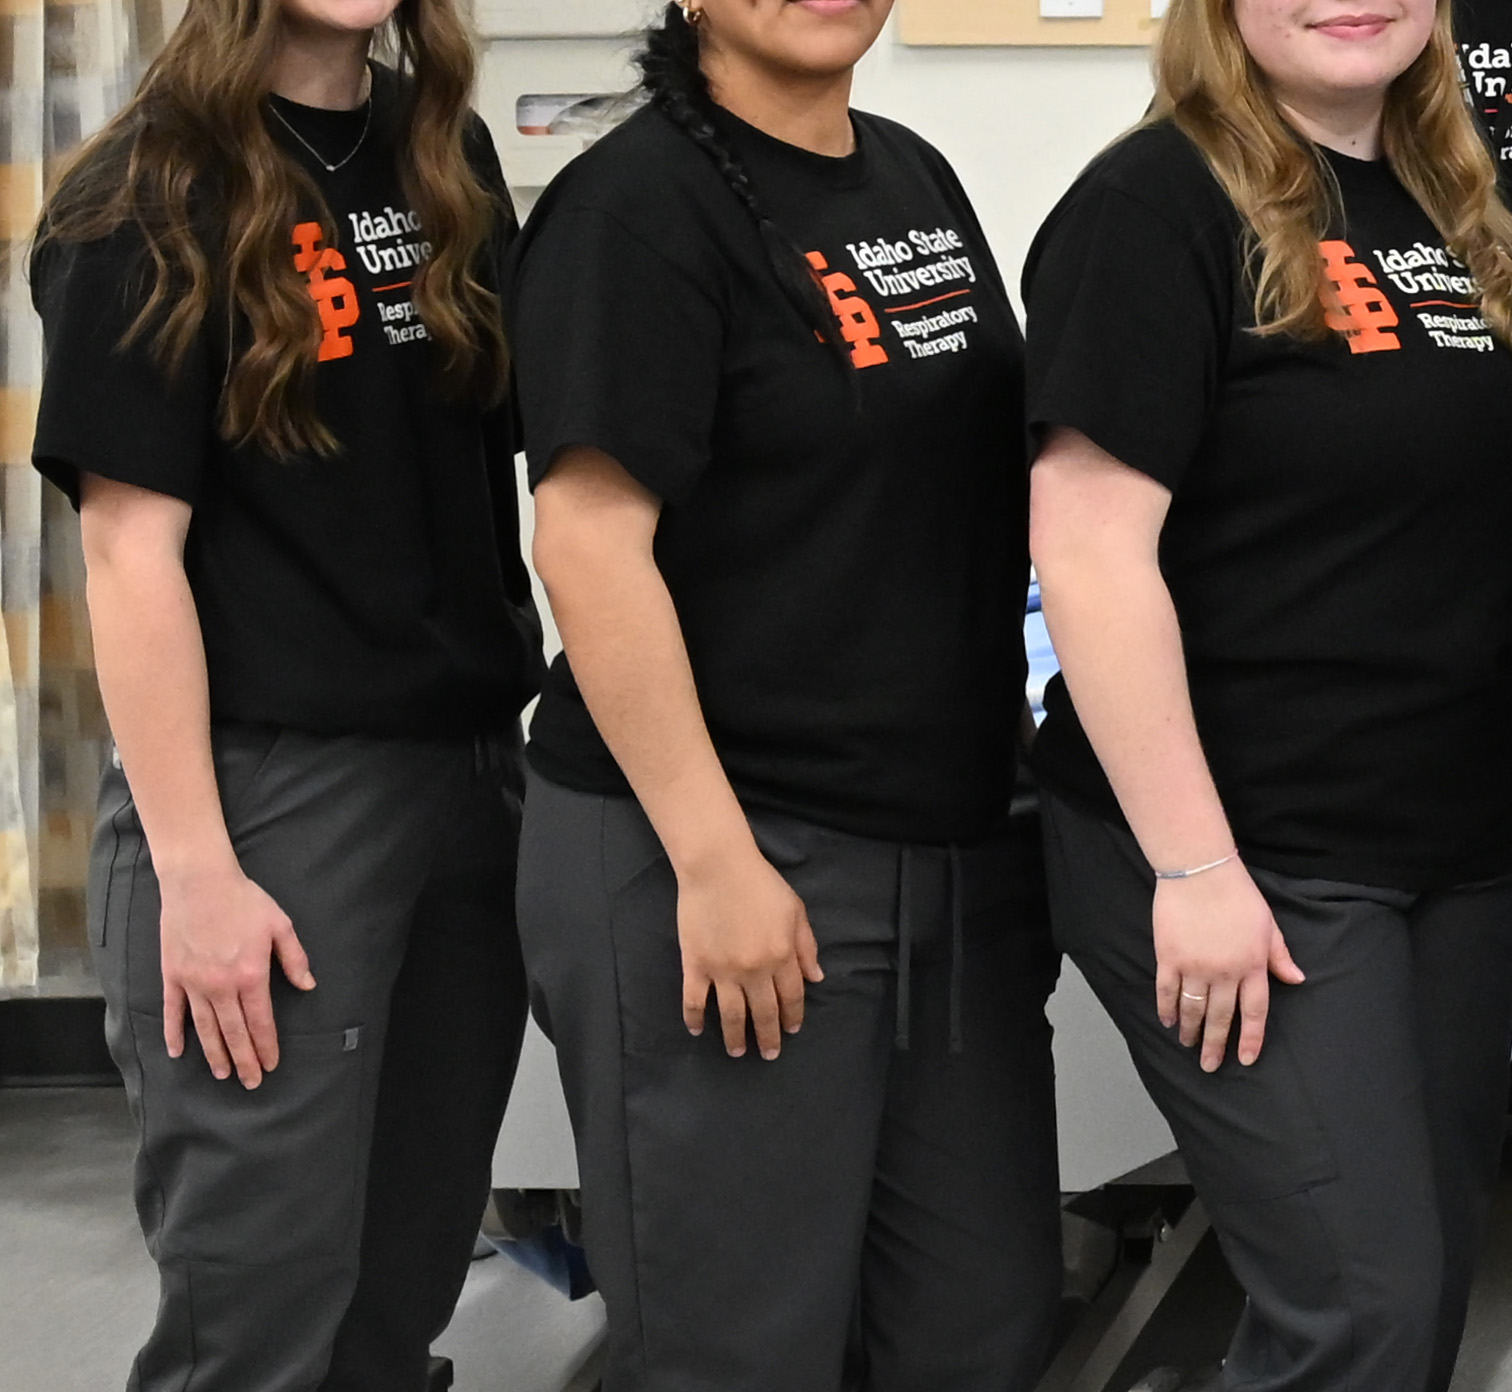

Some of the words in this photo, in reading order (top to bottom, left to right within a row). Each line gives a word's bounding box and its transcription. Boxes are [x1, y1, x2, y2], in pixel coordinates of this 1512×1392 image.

[356, 239, 433, 275] Unive
[846, 238, 913, 270] Idaho
[908, 227, 963, 256] State
[1373, 242, 1448, 274] Idaho
[863, 255, 976, 297] University
[1388, 266, 1480, 295] Univer
[384, 324, 433, 345] Thera
[891, 306, 978, 339] Respiratory
[1417, 313, 1491, 334] Respirato
[903, 330, 968, 359] Therapy
[1428, 330, 1494, 352] Therapy
